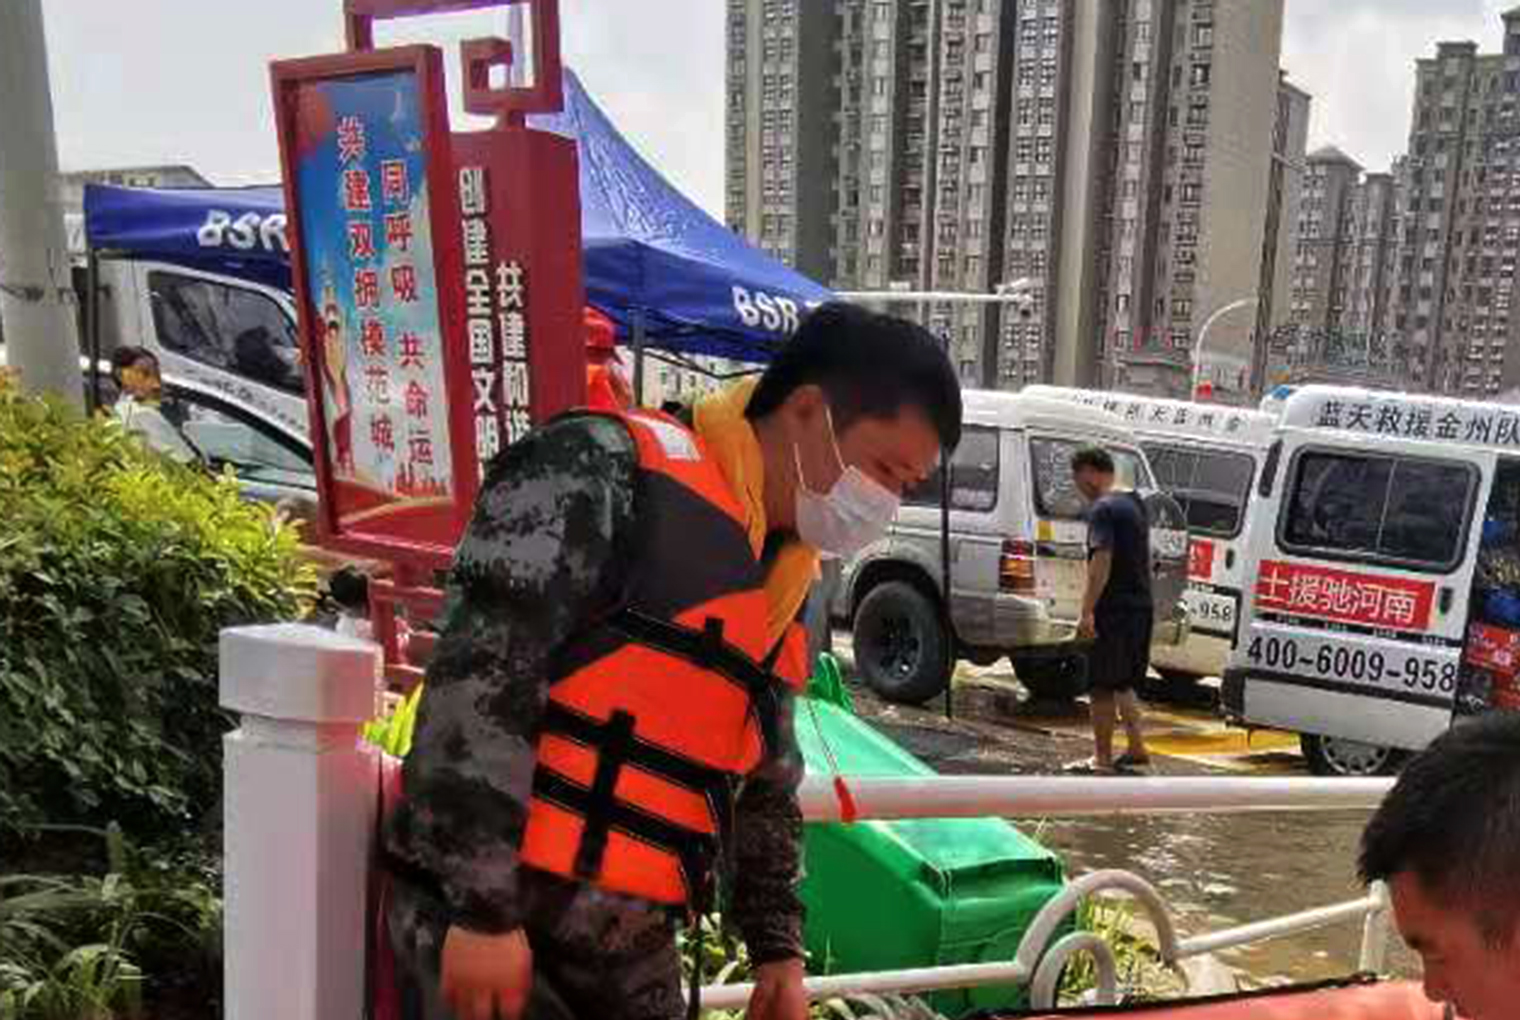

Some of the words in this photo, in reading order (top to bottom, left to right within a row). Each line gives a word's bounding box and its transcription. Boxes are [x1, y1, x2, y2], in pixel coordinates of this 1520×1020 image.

[380, 160, 419, 303] 同呼吸
[459, 166, 499, 484] 创建全国文明
[398, 331, 434, 465] 共命运
[1316, 400, 1520, 445] 蓝天救援金州队
[1247, 636, 1456, 692] 400-6009-958
